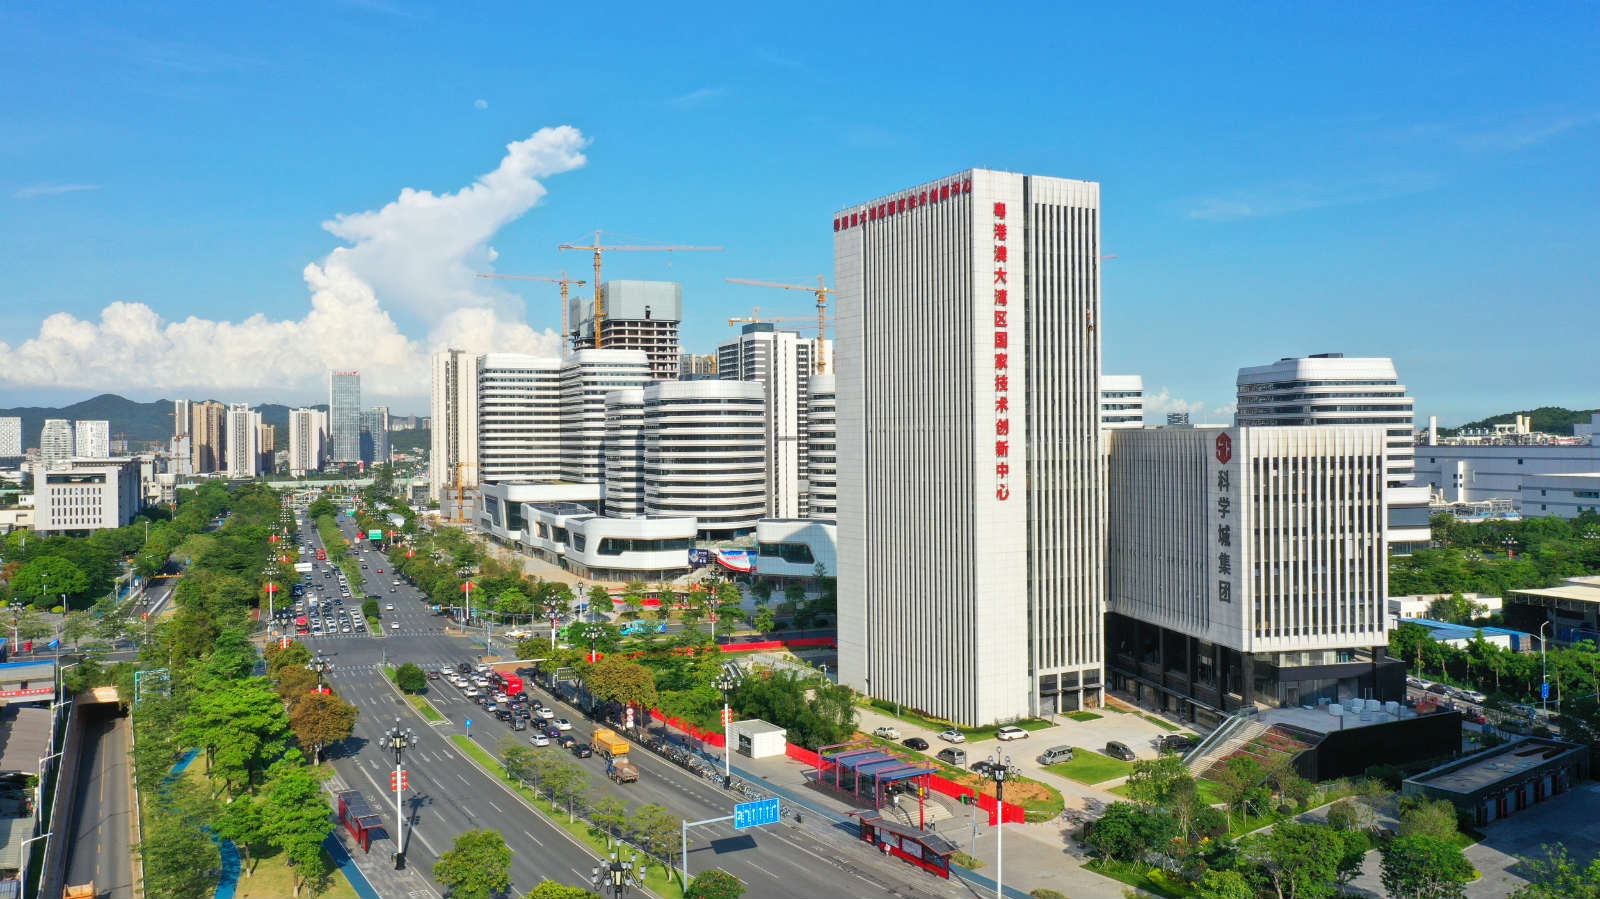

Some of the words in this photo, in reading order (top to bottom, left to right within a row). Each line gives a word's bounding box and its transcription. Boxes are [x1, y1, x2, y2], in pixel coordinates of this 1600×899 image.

[993, 202, 1009, 501] 粤港澳大湾区国家技术创新中心
[1218, 470, 1231, 603] 科学城集团
